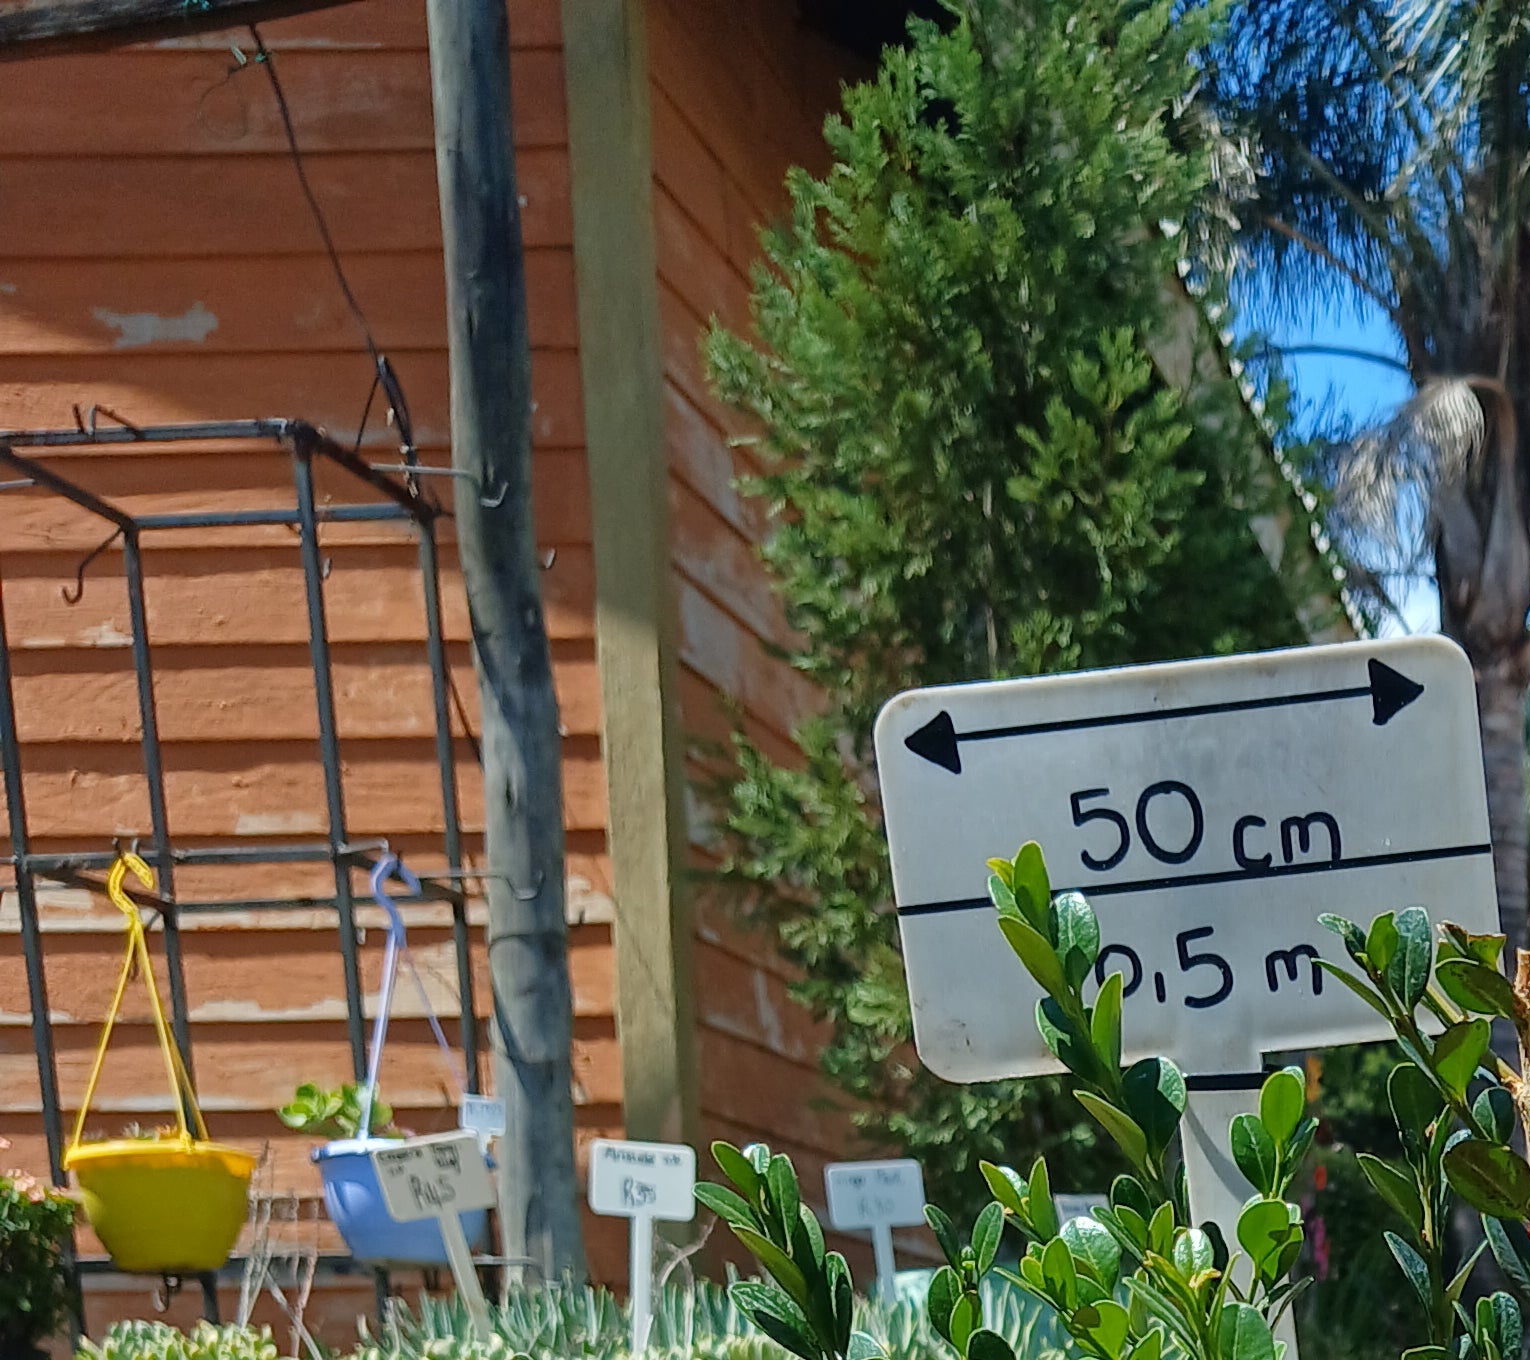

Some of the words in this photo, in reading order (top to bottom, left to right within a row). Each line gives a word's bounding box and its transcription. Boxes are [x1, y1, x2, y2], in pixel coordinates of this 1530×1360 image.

[1069, 780, 1205, 872] 50
[1232, 811, 1343, 871] cm
[1265, 943, 1322, 996] m
